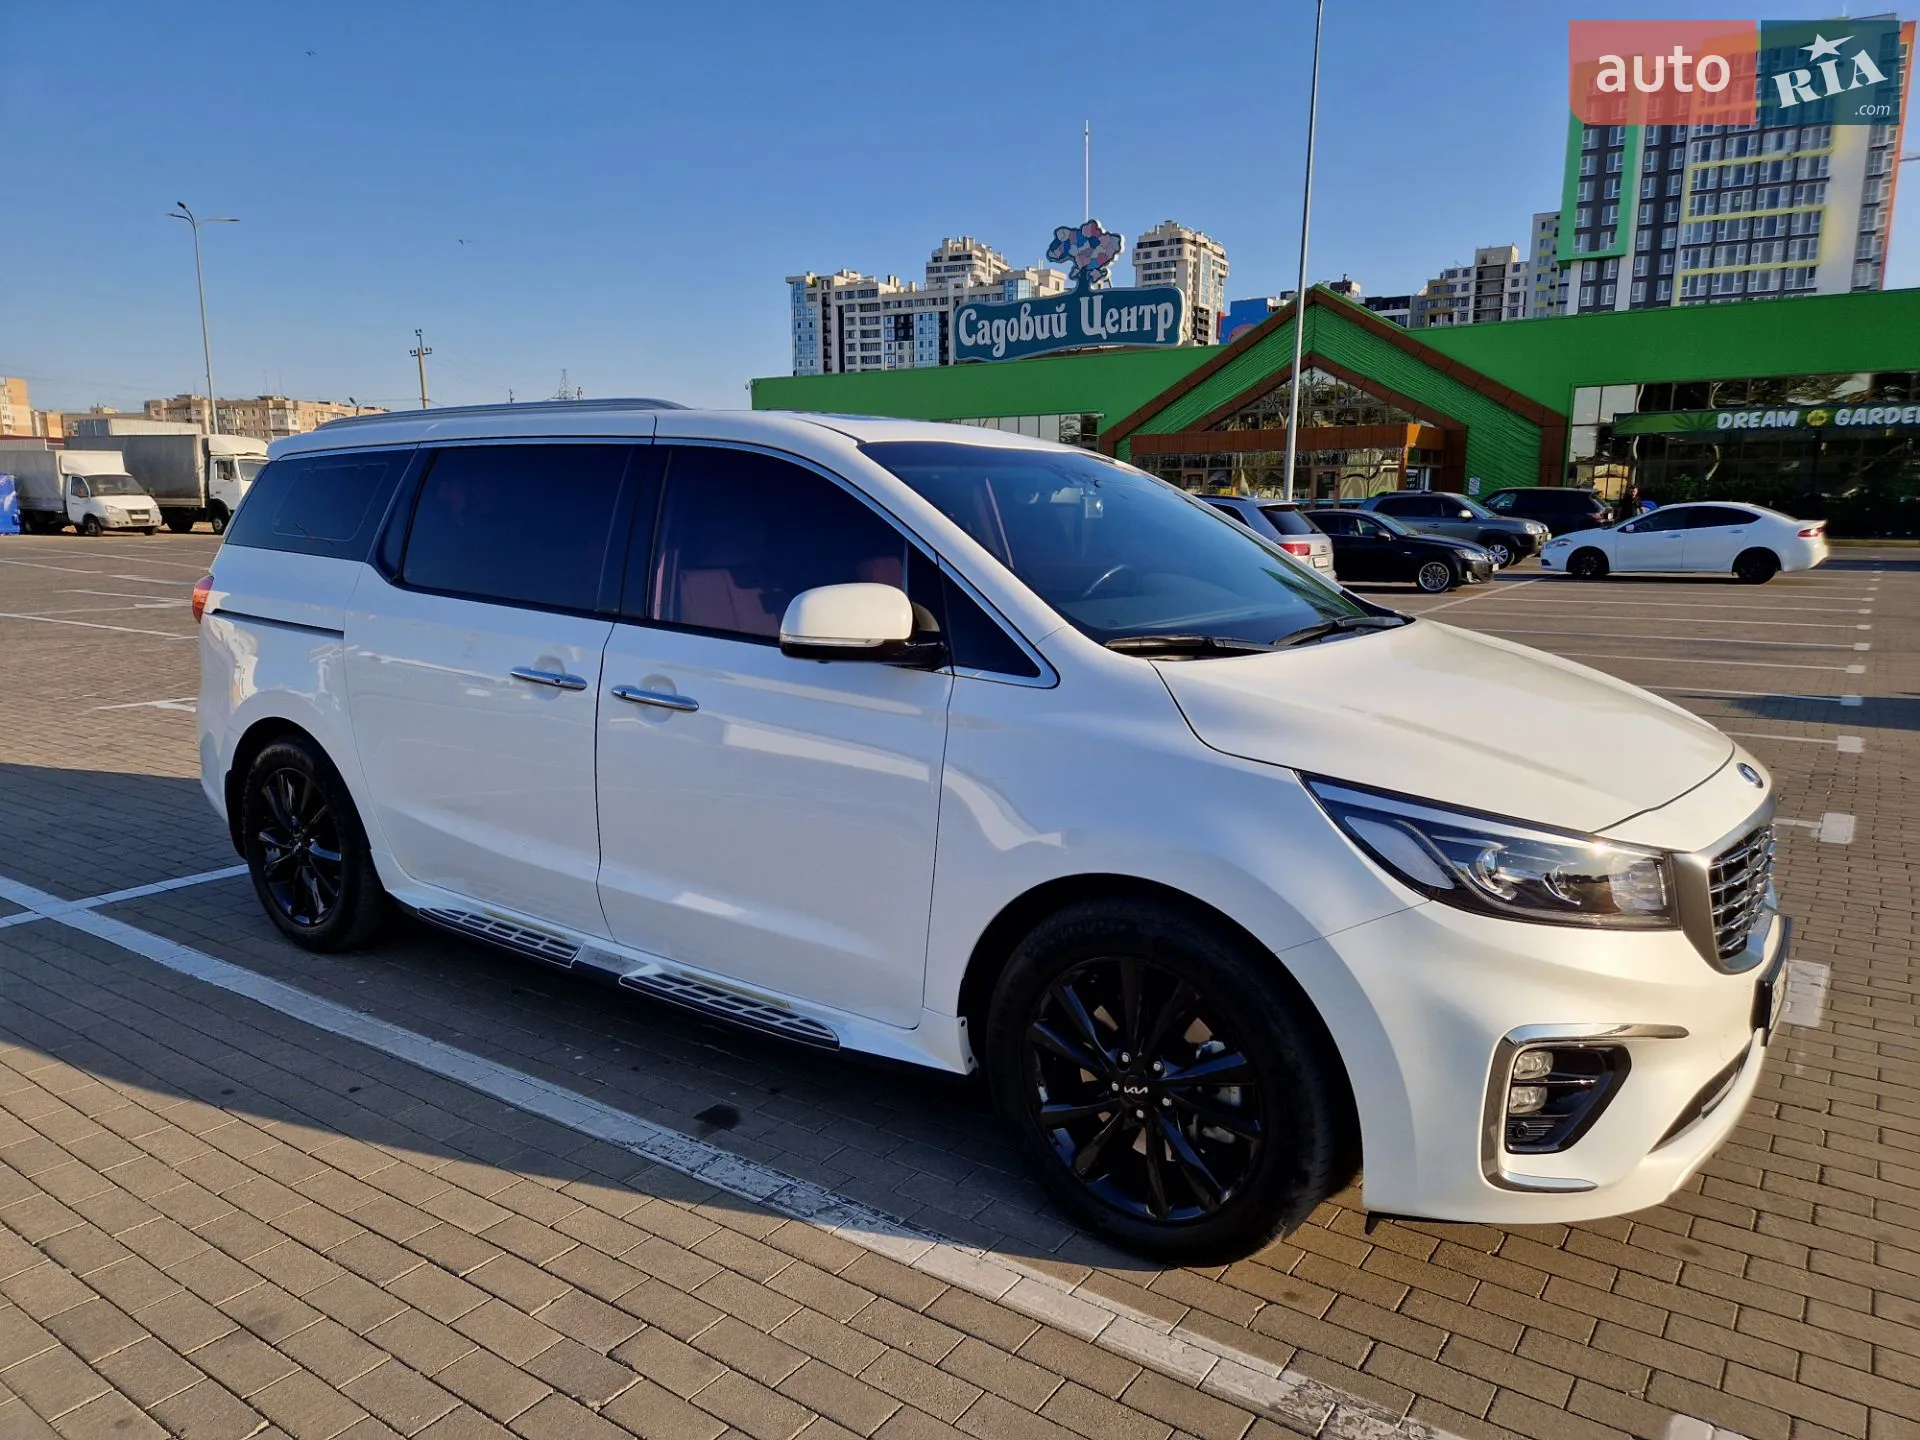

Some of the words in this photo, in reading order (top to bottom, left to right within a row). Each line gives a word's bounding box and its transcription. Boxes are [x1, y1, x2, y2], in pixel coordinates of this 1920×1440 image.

[958, 302, 1068, 358] Садовий
[1079, 295, 1175, 343] Центр
[1717, 410, 1799, 429] DREAM
